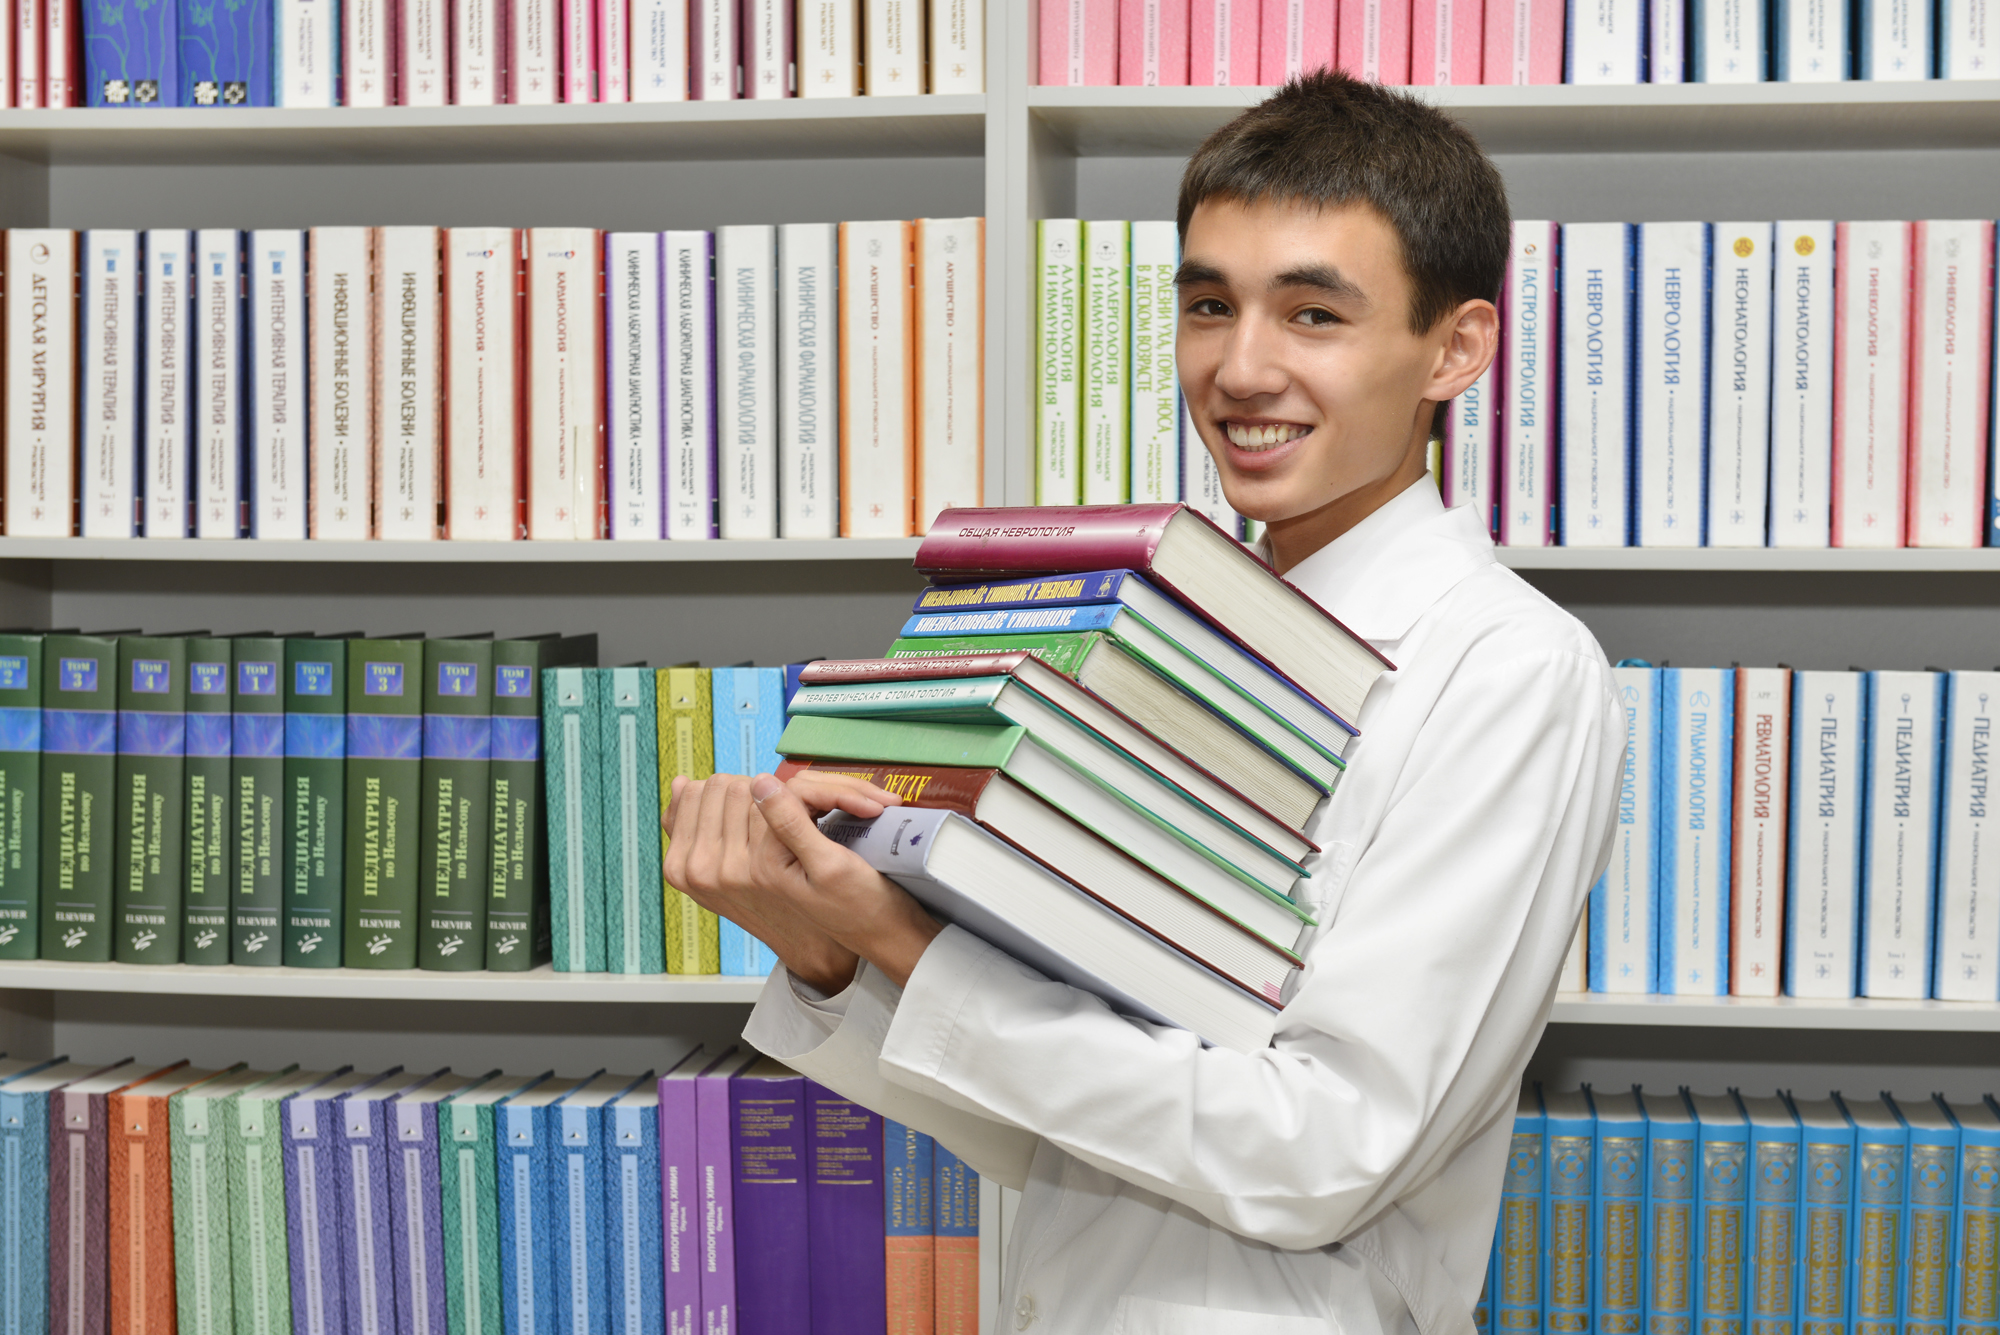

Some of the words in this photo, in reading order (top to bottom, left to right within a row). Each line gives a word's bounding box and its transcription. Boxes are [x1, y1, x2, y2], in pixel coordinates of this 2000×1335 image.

[627, 250, 641, 310] КЛИНИЧЕСКАЯ
[679, 249, 692, 310] КЛИНИЧЕСКАЯ
[945, 261, 955, 327] АКУШЕРСТВО
[1046, 265, 1057, 276] И
[1092, 267, 1103, 279] И
[1137, 265, 1151, 273] В
[1156, 264, 1172, 319] БОЛЕЗНИ
[32, 274, 47, 344] ДЕТСКАЯ
[103, 278, 118, 366] ИНТЕНСИВНАЯ
[161, 281, 176, 370] ИНТЕНСИВНАЯ
[211, 281, 226, 370] ИНТЕНСИВНАЯ
[271, 280, 286, 368] ИНТЕНСИВНАЯ
[334, 273, 349, 378] ИНФЕКЦИОННЫЕ
[401, 272, 416, 378] ИНФЕКЦИОННЫЕ
[475, 271, 485, 352] КАРДИОЛОГИЯ
[557, 272, 567, 353] КАРДИОЛОГИЯ
[738, 267, 756, 348] КЛИНИЧЕСКАЯ
[798, 267, 816, 347] КЛИНИЧЕСКАЯ
[870, 265, 879, 330] АКУШЕРСТВО
[1060, 264, 1073, 382] АЛЛЕРГОЛОГИЯ
[1136, 275, 1152, 332] ДЕТСКОМ
[1867, 268, 1879, 356] ГИНЕКОЛОГИЯ
[1944, 266, 1957, 355] ГИНЕКОЛОГИЯ
[628, 313, 641, 375] ЛАБОРАТОРНАЯ
[680, 311, 693, 375] ЛАБОРАТОРНАЯ
[1045, 280, 1058, 405] ИММУНОЛОГИЯ
[1091, 283, 1104, 408] ИММУНОЛОГИЯ
[1106, 267, 1119, 385] АЛЛЕРГОЛОГИЯ
[1155, 323, 1172, 350] УХА,
[1520, 268, 1537, 427] ГАСТРОЭНТЕРОЛОГИЯ
[1586, 269, 1603, 386] НЕВРОЛОГИЯ
[1664, 268, 1680, 385] НЕВРОЛОГИЯ
[1734, 268, 1748, 391] НЕОНАТОЛОГИЯ
[1795, 267, 1810, 390] НЕОНАТОЛОГИЯ
[32, 349, 47, 431] ХИРУРГИЯ
[1136, 335, 1152, 392] ВОЗРАСТЕ
[1155, 353, 1172, 395] ГОРЛА,
[103, 369, 117, 421] ТЕРАПИЯ
[161, 373, 175, 425] ТЕРАПИЯ
[212, 373, 226, 425] ТЕРАПИЯ
[272, 372, 286, 424] ТЕРАПИЯ
[335, 381, 349, 437] БОЛЕЗНИ
[401, 381, 416, 437] БОЛЕЗНИ
[629, 378, 642, 439] ДИАГНОСТИКА
[680, 378, 693, 439] ДИАГНОСТИКА
[738, 351, 756, 444] ФАРМАКОЛОГИЯ
[798, 350, 816, 444] ФАРМАКОЛОГИЯ
[1157, 398, 1172, 433] НОСА
[959, 527, 1000, 539] ОБЩАЯ
[1002, 527, 1075, 537] НЕВРОЛОГИЯ
[920, 585, 986, 607] ЗДРАВООХРАНЕНИЯ
[985, 583, 1032, 603] ЭКОНОМИКА
[1037, 579, 1086, 598] УПРАВЛЕНИЕ
[914, 611, 1009, 632] ЗДРАВООХРАНЕНИЯ
[1006, 609, 1077, 628] ЭКОНОМИКА
[4, 671, 13, 685] 2
[67, 662, 90, 672] ТОМ
[73, 674, 82, 688] 3
[140, 663, 162, 674] ТОМ
[145, 675, 154, 689] 4
[197, 666, 219, 676] ТОМ
[202, 677, 211, 690] 5
[245, 665, 268, 675] ТОМ
[252, 677, 260, 690] 1
[302, 665, 325, 676] ТОМ
[308, 676, 317, 690] 2
[372, 666, 396, 676] ТОМ
[379, 677, 388, 692] 3
[446, 666, 469, 676] ТОМ
[452, 678, 461, 692] 4
[502, 669, 525, 678] ТОМ
[508, 679, 517, 693] 5
[816, 662, 895, 673] ТЕРАПЕВТИЧЕСКАЯ
[896, 660, 973, 670] СТОМАТОЛОГИЯ
[804, 692, 881, 703] ТЕРАПЕВТИЧЕСКАЯ
[885, 688, 956, 699] СТОМАТОЛОГИЯ
[883, 773, 932, 803] АТЛАС
[1689, 712, 1707, 830] ПУЛЬМОНОЛОГИЯ
[1754, 714, 1773, 818] РЕВМАТОЛОГИЯ
[1819, 718, 1837, 818] ПЕДИАТРИЯ
[1893, 718, 1913, 818] ПЕДИАТРИЯ
[1970, 717, 1990, 818] ПЕДИАТРИЯ
[9, 788, 24, 847] Нельсону
[60, 772, 75, 890] ПЕДИАТРИЯ
[78, 791, 93, 853] Нельсону
[130, 774, 147, 892] ПЕДИАТРИЯ
[148, 793, 165, 856] Нельсону
[191, 775, 205, 893] ПЕДИАТРИЯ
[208, 794, 224, 857] Нельсону
[241, 776, 255, 894] ПЕДИАТРИЯ
[258, 794, 273, 858] Нельсону
[295, 776, 310, 895] ПЕДИАТРИЯ
[313, 795, 328, 859] Нельсону
[364, 777, 380, 896] ПЕДИАТРИЯ
[383, 796, 399, 860] Нельсону
[436, 778, 453, 897] ПЕДИАТРИЯ
[455, 797, 472, 861] Нельсону
[493, 779, 509, 898] ПЕДИАТРИЯ
[511, 798, 527, 862] Нельсону
[11, 852, 21, 869] по
[80, 856, 89, 872] по
[151, 858, 160, 874] по
[211, 859, 220, 875] по
[261, 860, 270, 876] по
[316, 860, 325, 877] по
[386, 862, 395, 878] по
[457, 863, 467, 879] по
[514, 864, 523, 880] по
[56, 912, 95, 922] ELSEVIER
[126, 914, 165, 925] ELSEVIER
[188, 915, 225, 925] ELSEVIER
[237, 917, 277, 927] ELSEVIER
[291, 918, 330, 928] ELSEVIER
[360, 919, 401, 929] ELSEVIER
[431, 920, 472, 930] ELSEVIER
[490, 921, 527, 931] ELSEVIER
[669, 1166, 678, 1199] ХИМИЯ
[706, 1166, 715, 1199] ХИМИЯ
[892, 1167, 902, 1227] СЛОВАРЬ
[919, 1178, 929, 1227] НОВЫЙ
[941, 1167, 951, 1227] СЛОВАРЬ
[968, 1178, 979, 1227] НОВЫЙ
